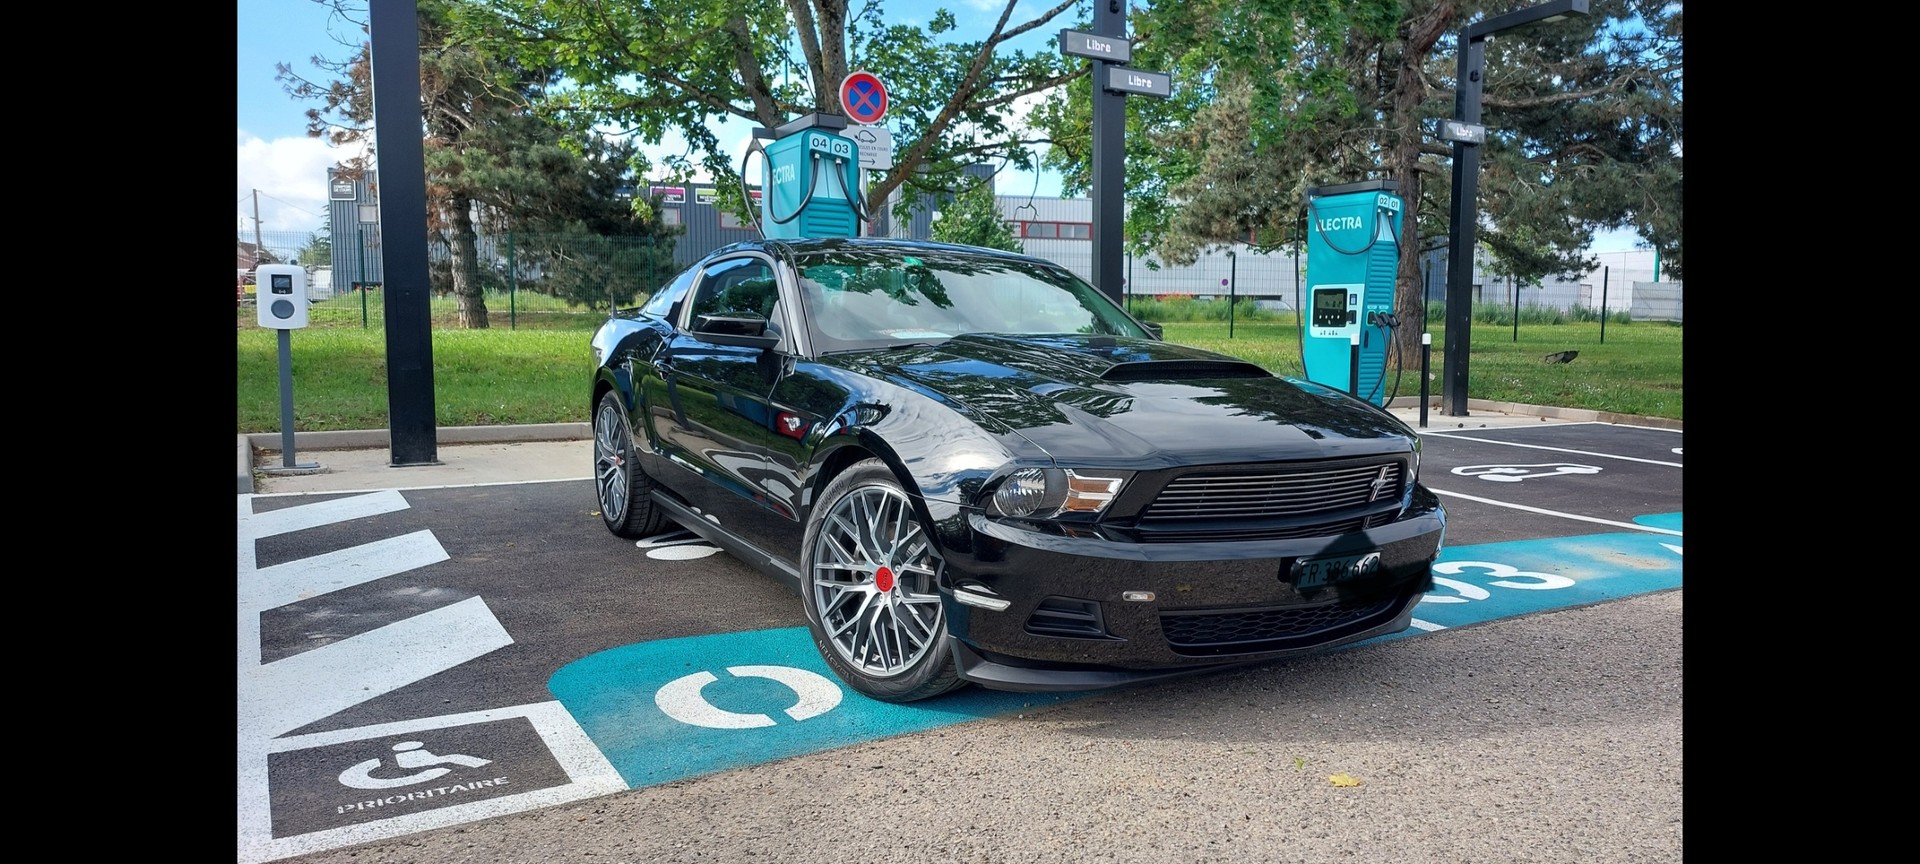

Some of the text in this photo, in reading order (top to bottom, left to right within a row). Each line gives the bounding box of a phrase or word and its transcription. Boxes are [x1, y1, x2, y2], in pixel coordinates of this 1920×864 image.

[1086, 39, 1112, 53] Libre
[1128, 74, 1152, 88] Libre
[1456, 126, 1473, 138] Libre
[812, 138, 827, 148] 04
[834, 143, 849, 154] 03
[1379, 196, 1388, 205] 02
[1391, 200, 1399, 208] 01
[337, 776, 511, 814] PRIORITAIRE
